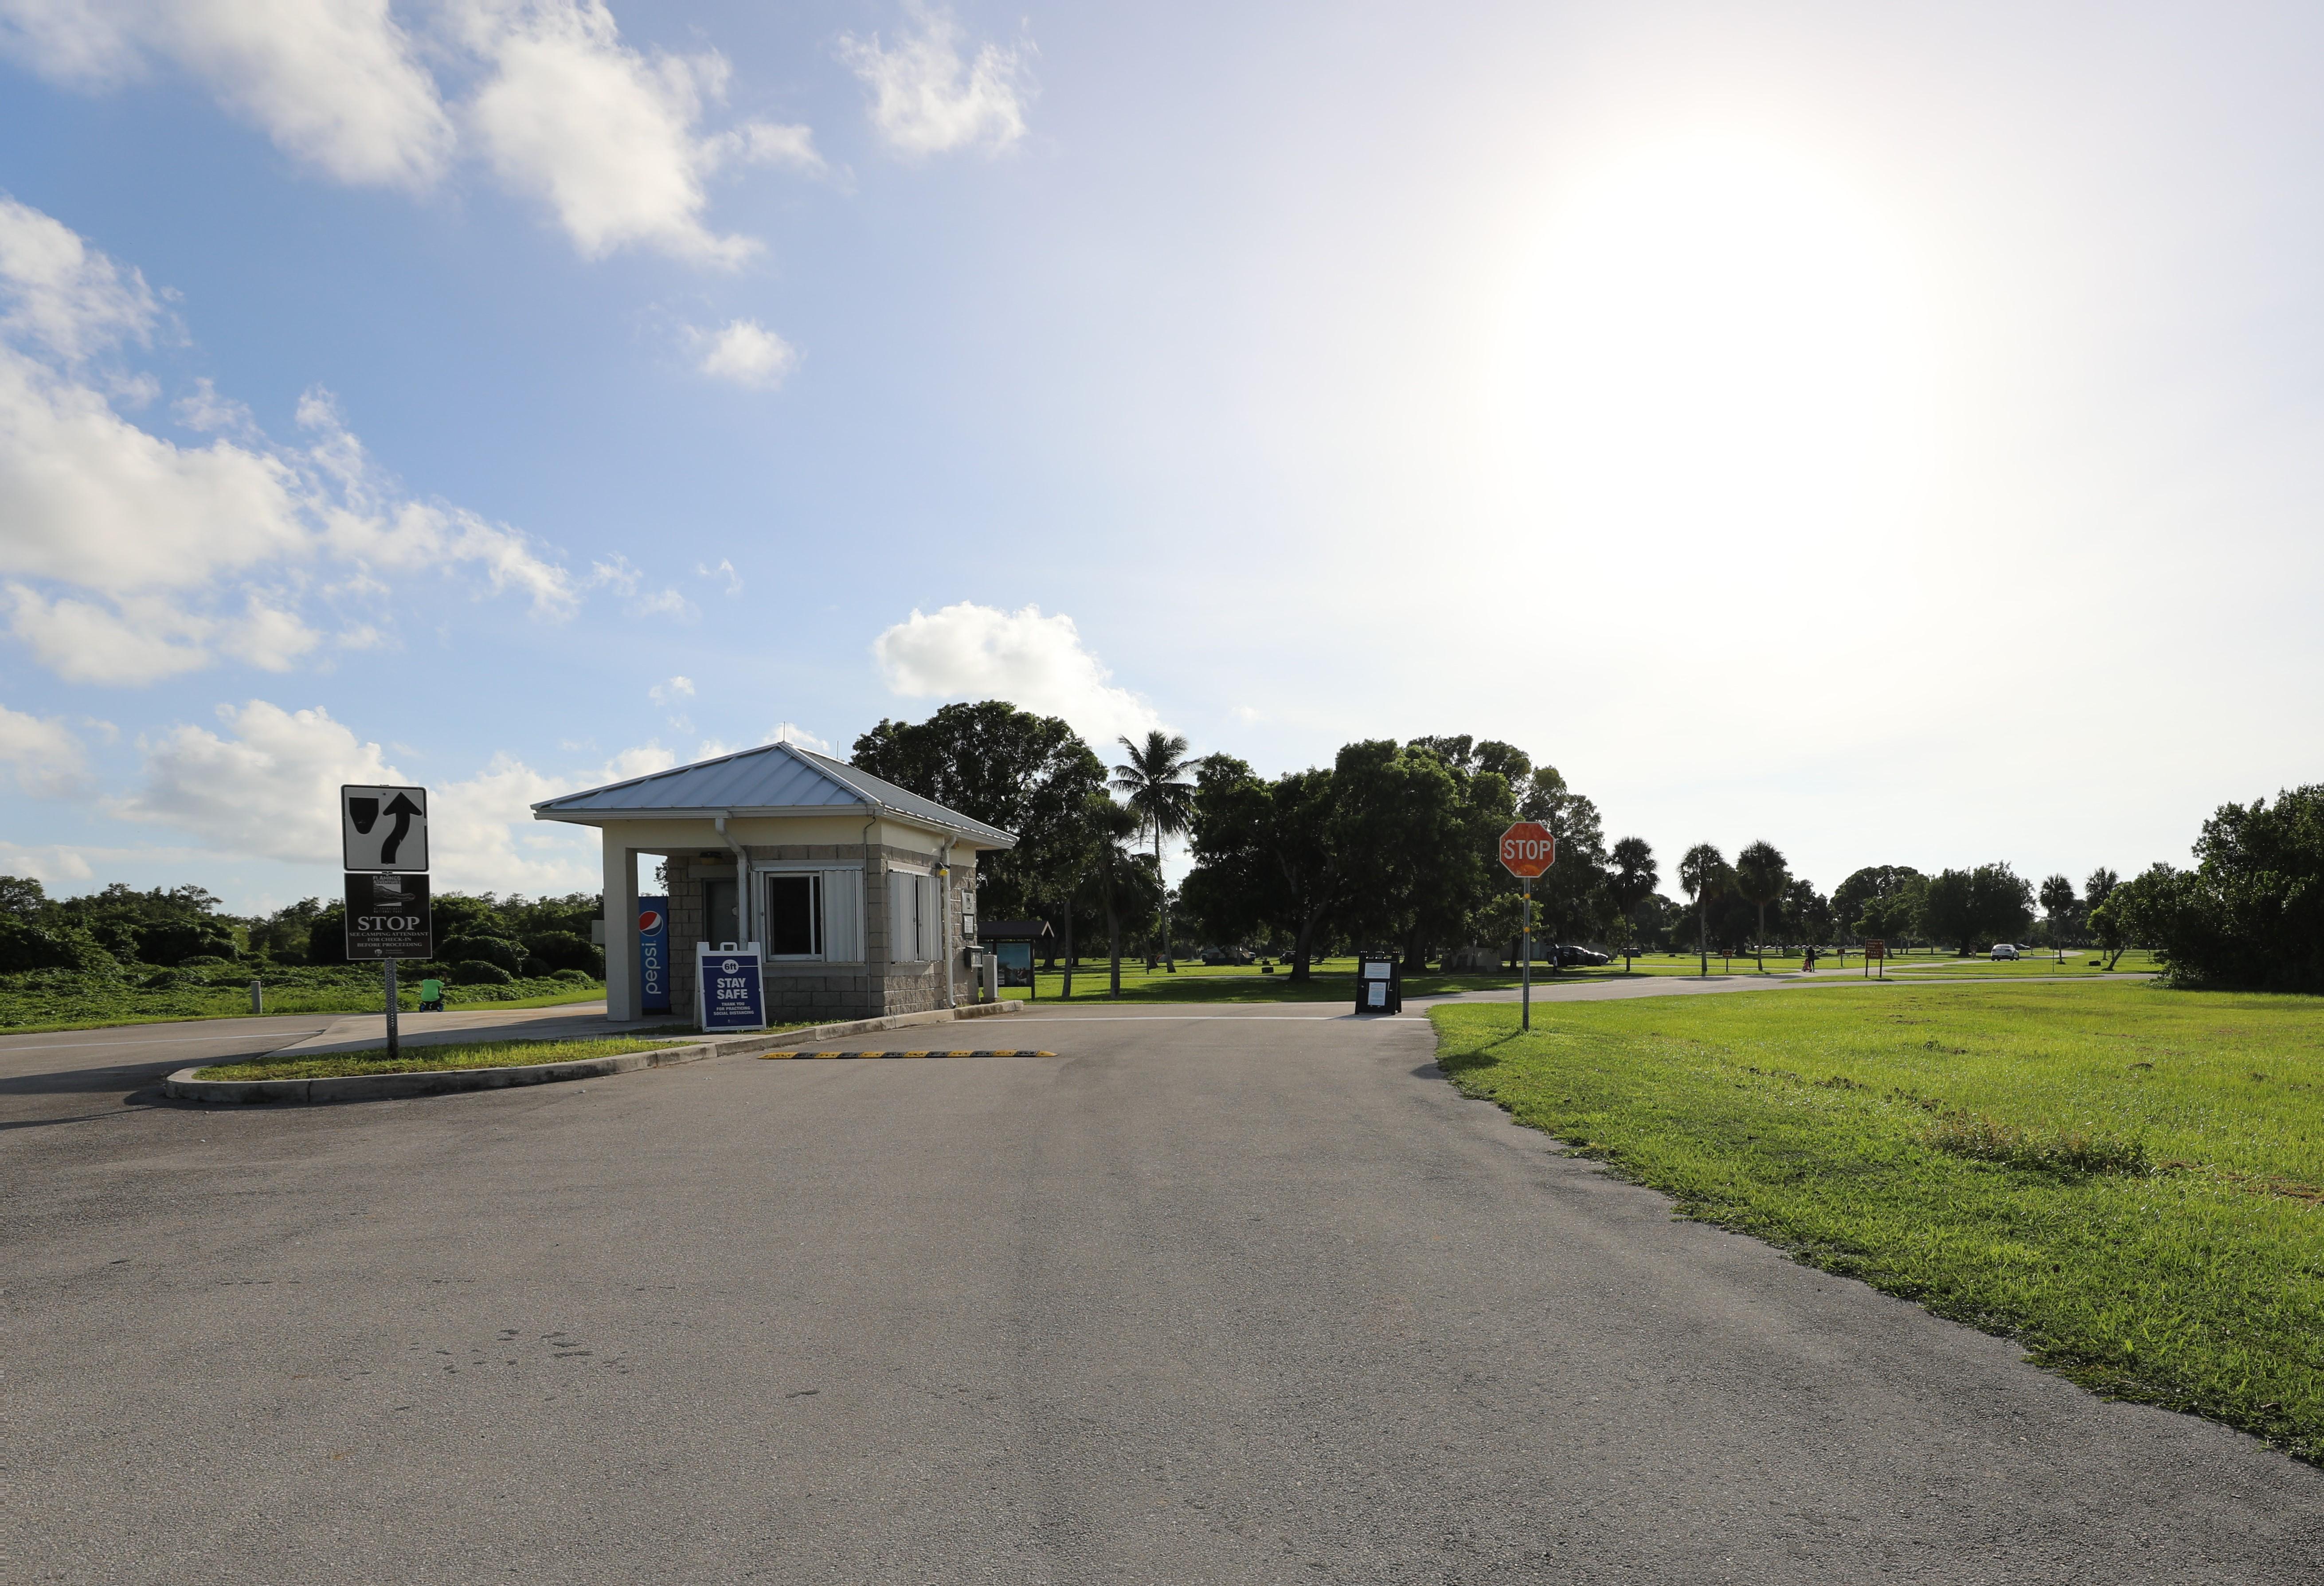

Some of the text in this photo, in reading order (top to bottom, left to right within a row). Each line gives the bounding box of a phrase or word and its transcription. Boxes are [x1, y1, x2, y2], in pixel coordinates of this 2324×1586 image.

[1504, 840, 1551, 859] STOP
[358, 916, 420, 930] STOP
[642, 943, 661, 994] pepsi
[717, 978, 746, 988] STAY
[717, 989, 748, 999] SAFE
